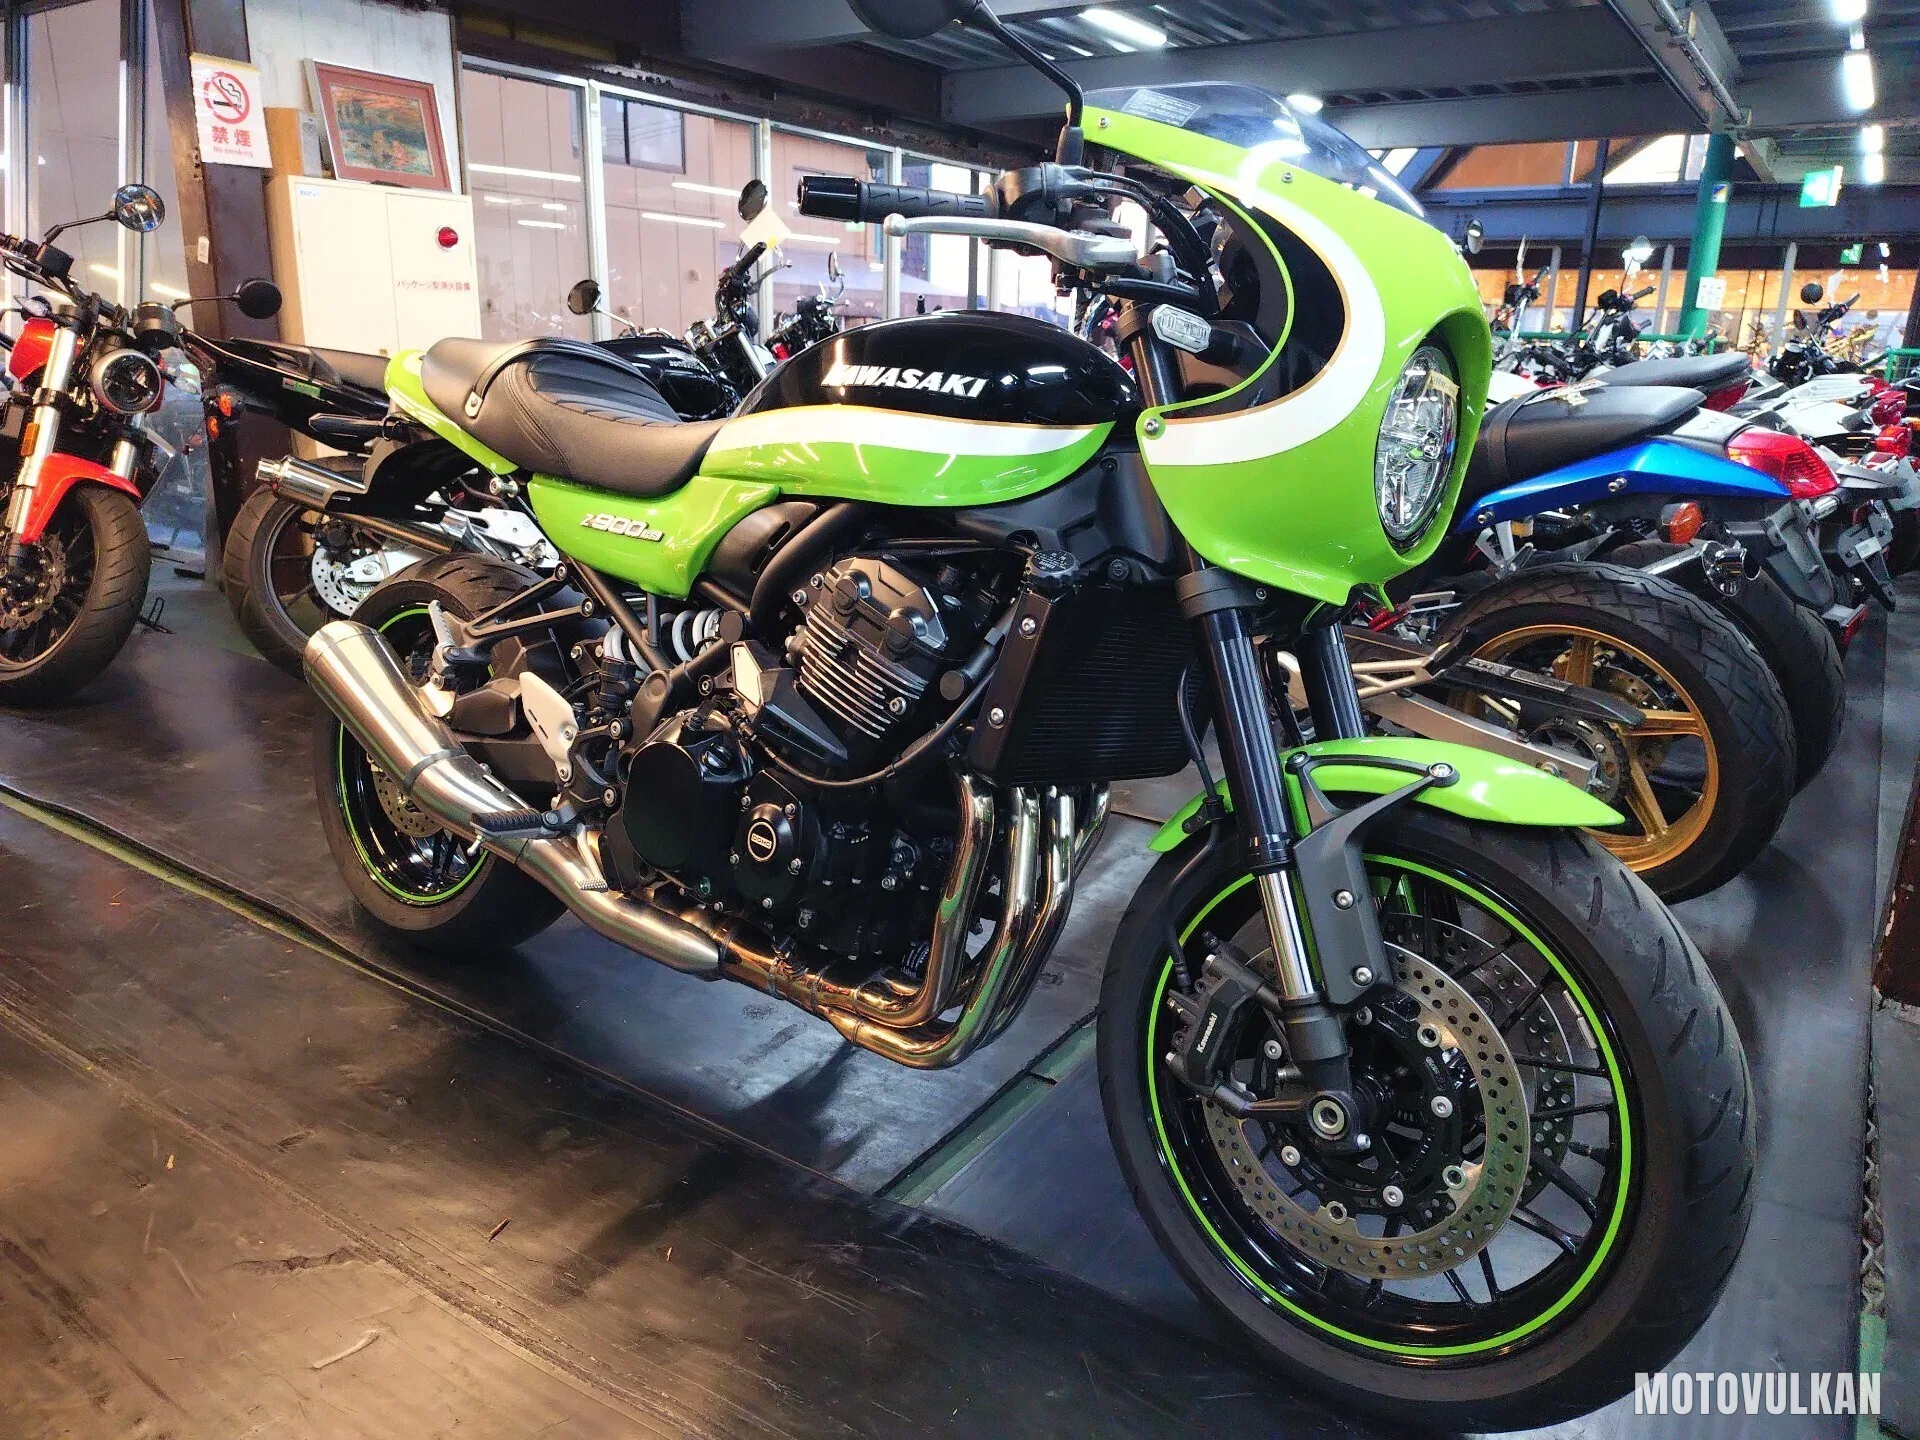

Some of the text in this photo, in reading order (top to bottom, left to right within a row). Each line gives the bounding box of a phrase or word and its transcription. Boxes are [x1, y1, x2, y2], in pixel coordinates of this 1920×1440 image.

[212, 126, 252, 147] 禁煙
[213, 145, 254, 158] No smoking
[1196, 1012, 1218, 1053] Kawasaki
